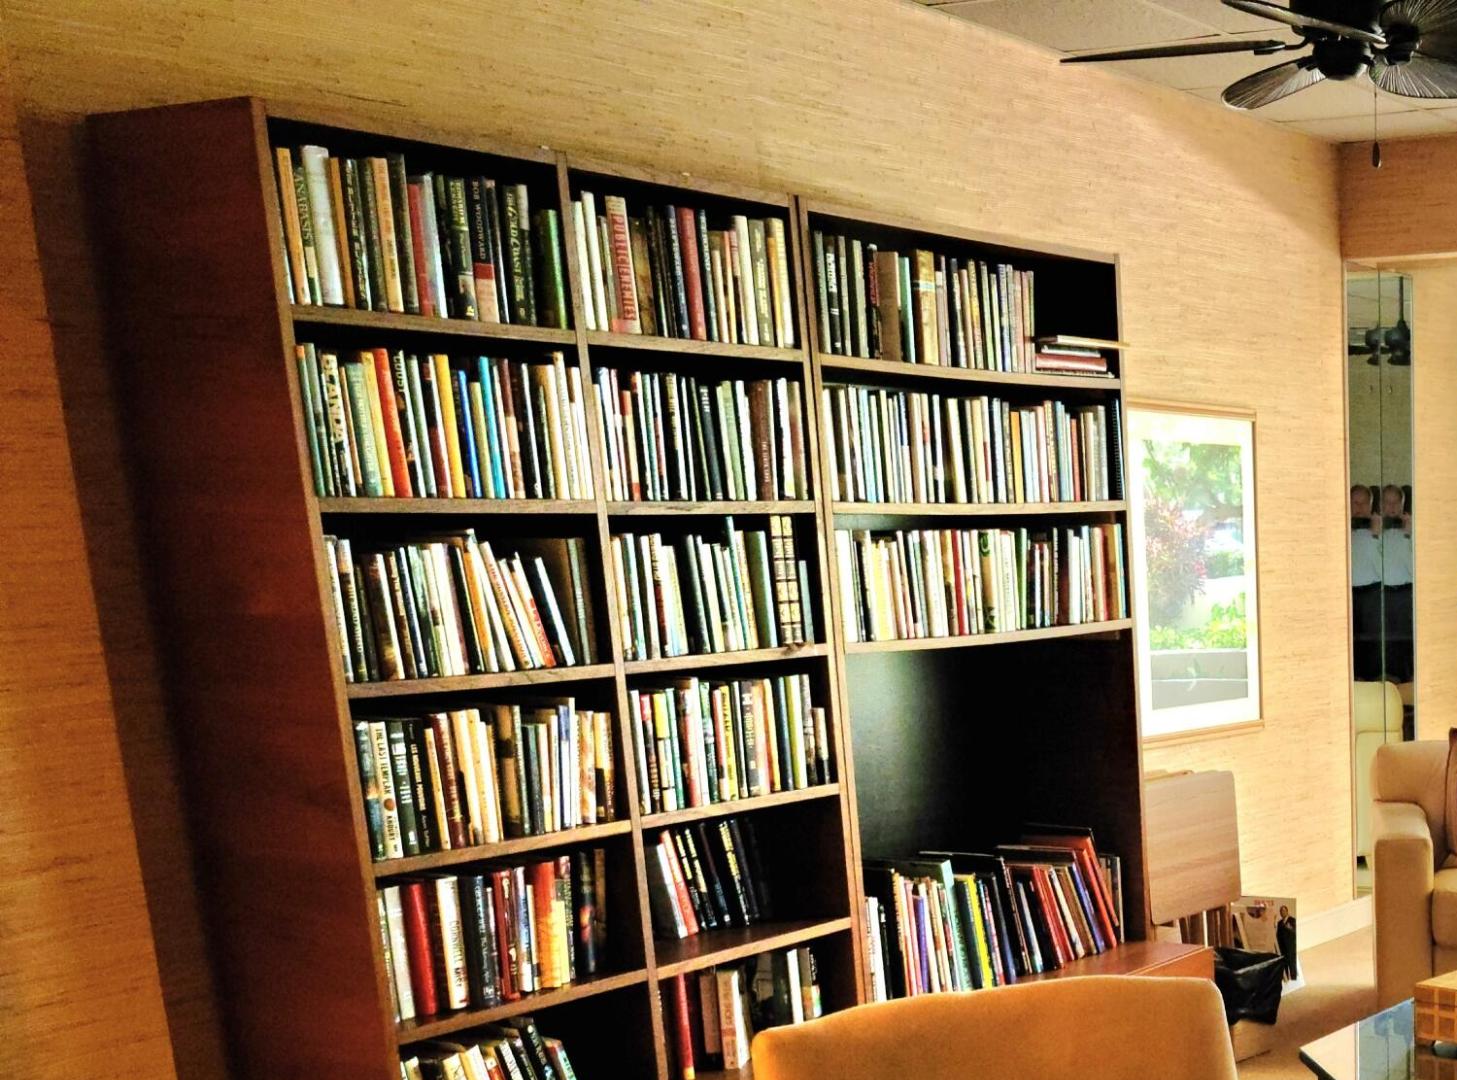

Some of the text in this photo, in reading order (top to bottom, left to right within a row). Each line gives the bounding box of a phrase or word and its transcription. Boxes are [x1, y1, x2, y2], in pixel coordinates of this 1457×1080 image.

[472, 180, 486, 260] BOB WOODWARD
[509, 236, 522, 273] COAST
[612, 214, 635, 320] PUBLIC ENEMIES
[375, 728, 391, 795] THE LAST TEMPLAR
[449, 919, 464, 963] CORNWELL
